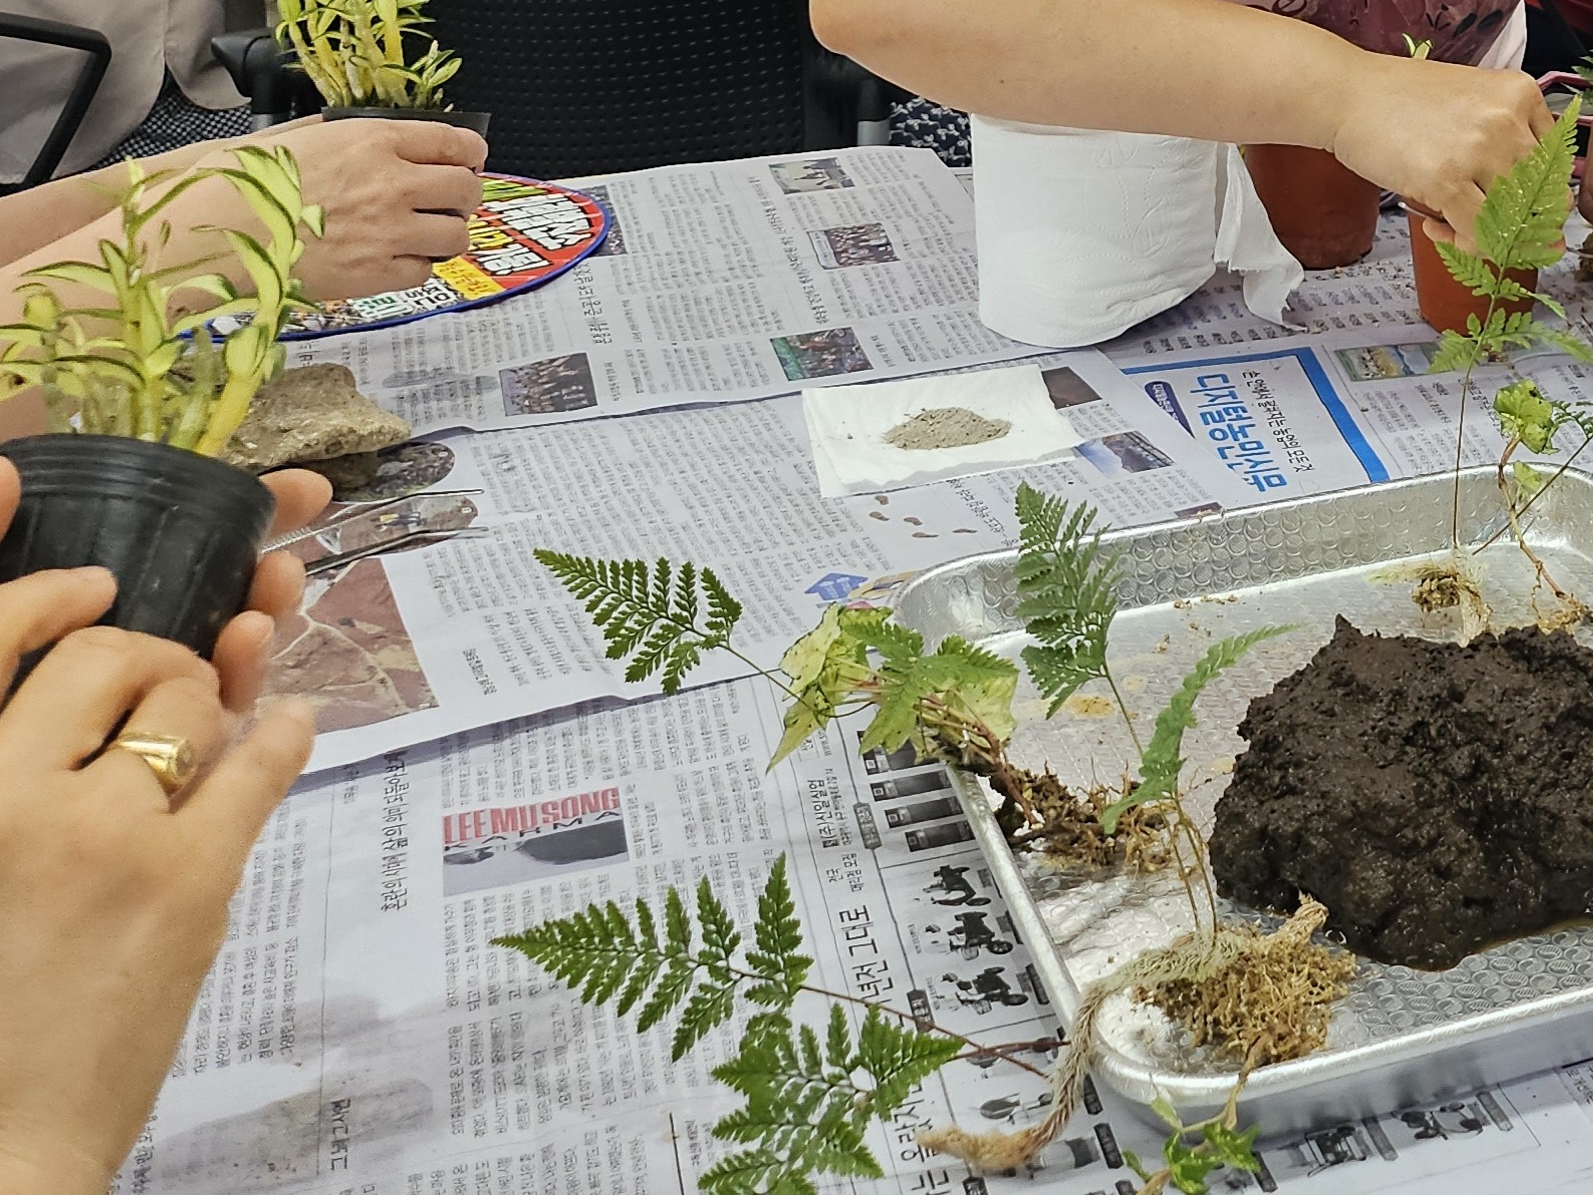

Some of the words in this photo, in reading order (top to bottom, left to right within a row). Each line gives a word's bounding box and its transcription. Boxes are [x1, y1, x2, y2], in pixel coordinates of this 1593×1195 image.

[381, 823, 409, 851] 삶의
[841, 853, 858, 868] 모집
[826, 868, 844, 883] 전국
[381, 877, 409, 912] 혼란의
[838, 905, 879, 957] 그대로
